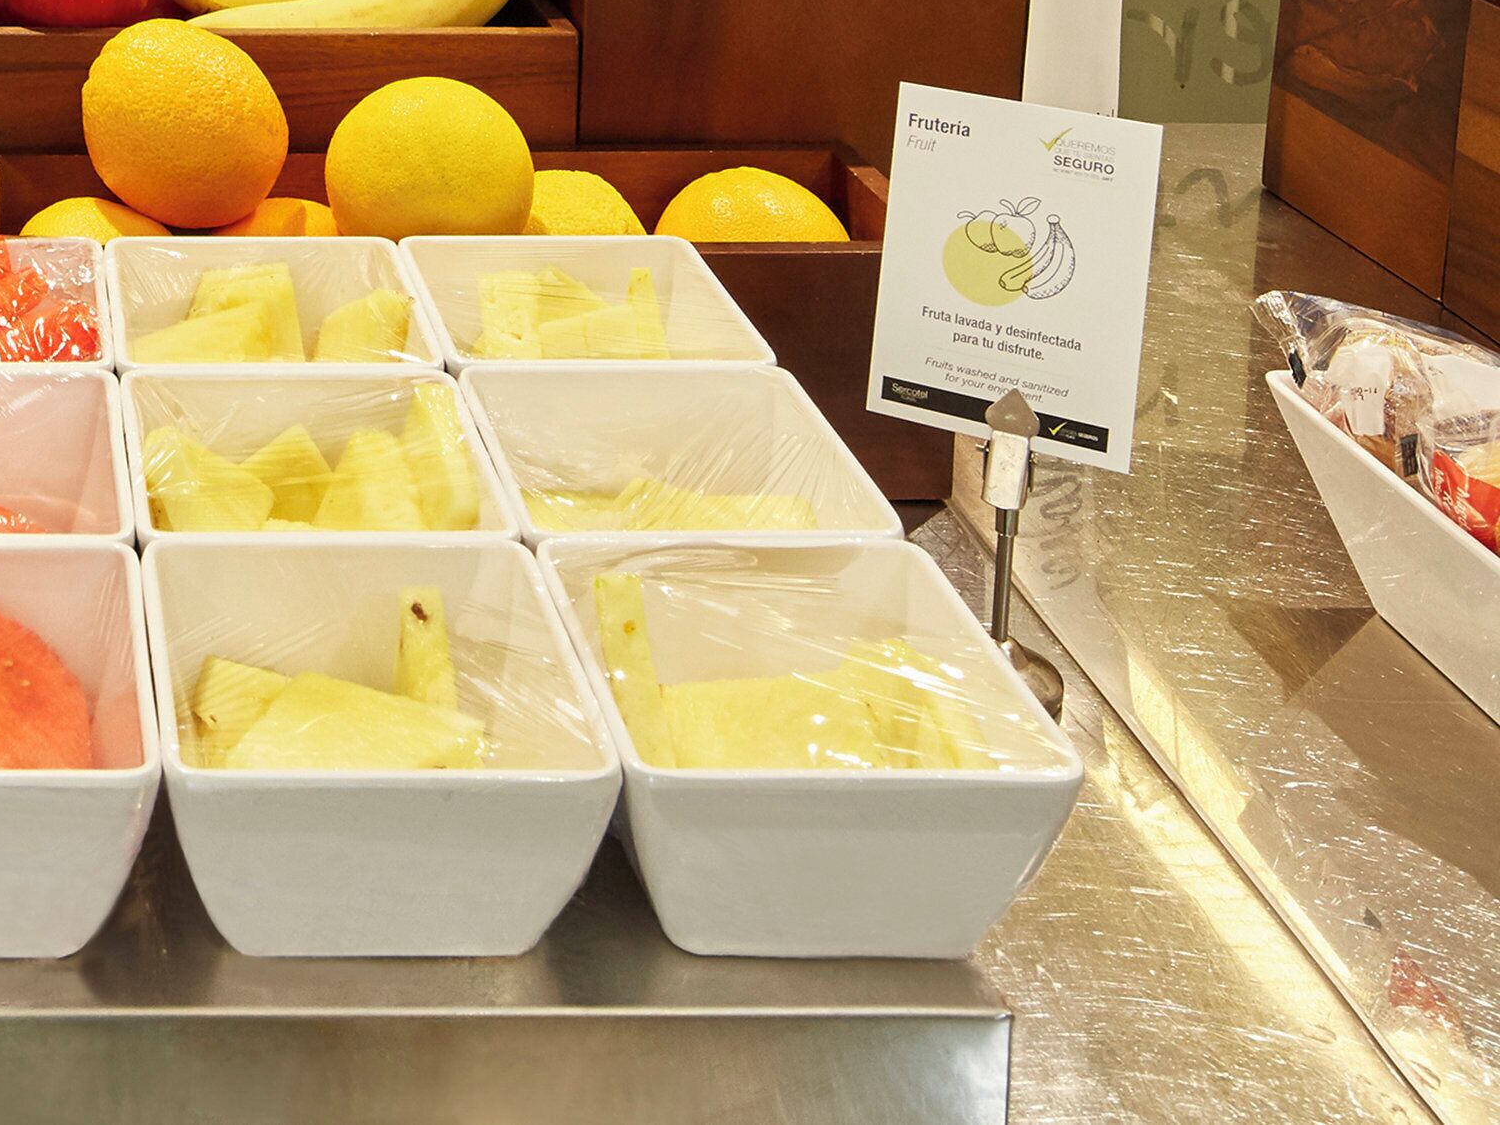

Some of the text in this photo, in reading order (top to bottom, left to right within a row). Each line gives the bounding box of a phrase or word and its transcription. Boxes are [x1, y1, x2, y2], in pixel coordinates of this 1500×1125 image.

[906, 134, 937, 152] Fruit
[1053, 155, 1115, 175] SEGURO
[921, 306, 952, 323] Fruta
[954, 313, 992, 332] lavada
[1005, 325, 1082, 351] desinfectada
[952, 331, 1045, 361] para tu disfrute.
[925, 357, 1070, 399] Fruits washed and sanitized
[944, 372, 1044, 404] for your enjoent.
